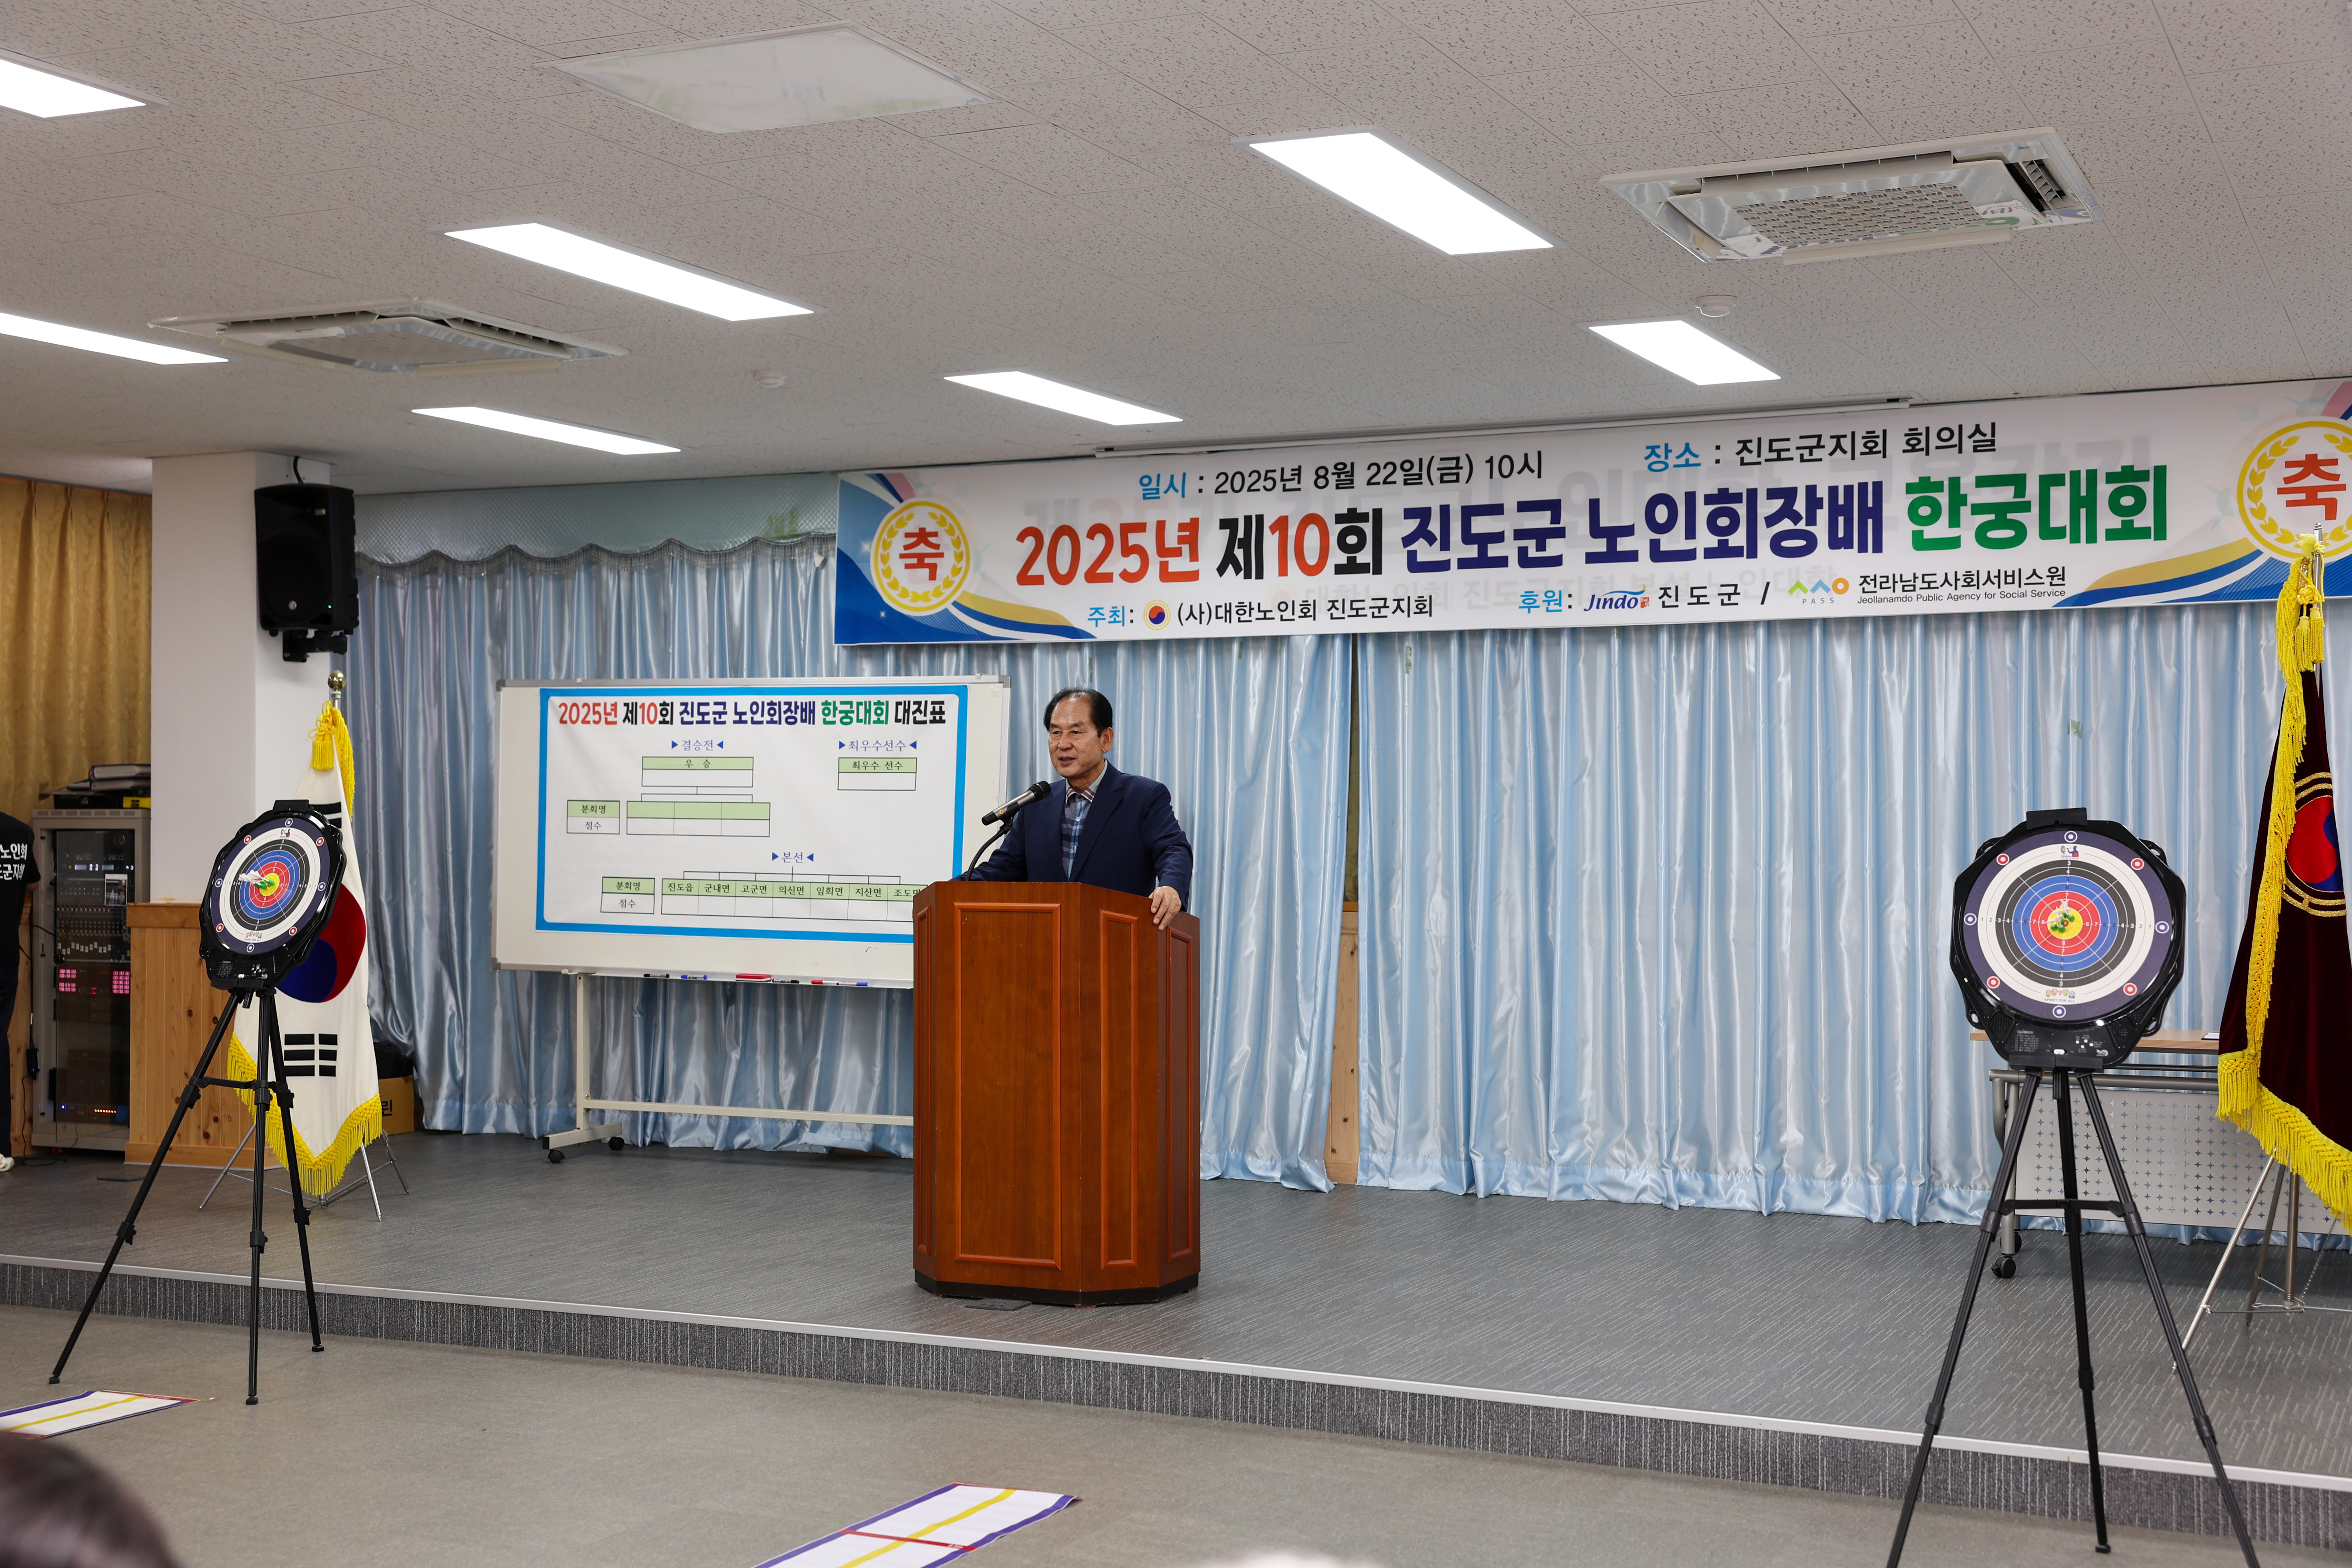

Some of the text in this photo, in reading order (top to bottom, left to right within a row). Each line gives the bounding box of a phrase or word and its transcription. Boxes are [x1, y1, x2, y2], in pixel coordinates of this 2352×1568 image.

[1644, 443, 1701, 472] 장소
[1736, 429, 1887, 466] 진도군지회
[1903, 422, 1996, 456] 회의실
[1140, 472, 1186, 500] 일시
[1214, 465, 1301, 494] 2025년
[1314, 462, 1354, 490] 8월
[1367, 454, 1473, 486] 22일(금)
[1485, 451, 1541, 479] 10시
[2277, 453, 2347, 521] 축
[1016, 465, 2167, 586] 2025년 제10회 진도군 노인회장배 한궁대회
[898, 526, 945, 581] 축
[1859, 566, 2065, 593] 전라남도사회서비스원
[1519, 590, 1572, 613] 후원:
[1584, 593, 1638, 612] Jindo
[1659, 584, 1740, 608] 진도군
[1858, 595, 1913, 604] Jeollanamdo
[1916, 593, 1943, 602] Public
[1947, 592, 1981, 602] Agency
[2000, 590, 2027, 599] Social
[2031, 589, 2065, 597] Service
[1088, 595, 1432, 627] 주최: (사)대한노인회 진도군지회
[559, 700, 946, 725] 2025년 제10회 진도군 노인회장배 한궁대회 대진표
[681, 739, 713, 751] 결승전
[848, 739, 907, 752] 최우수선수
[852, 761, 903, 770] 최우수 선수
[581, 805, 606, 814] 분회명
[585, 821, 601, 830] 점수
[0, 843, 27, 860] 노인회
[781, 851, 804, 864] 본선
[616, 881, 640, 891] 분회명
[668, 883, 693, 892] 진도읍
[704, 884, 730, 893] 군내면
[741, 885, 767, 894] 고군면
[779, 886, 804, 895] 의신면
[816, 887, 843, 897] 임회면
[855, 887, 881, 897] 지산면
[619, 899, 636, 908] 점수
